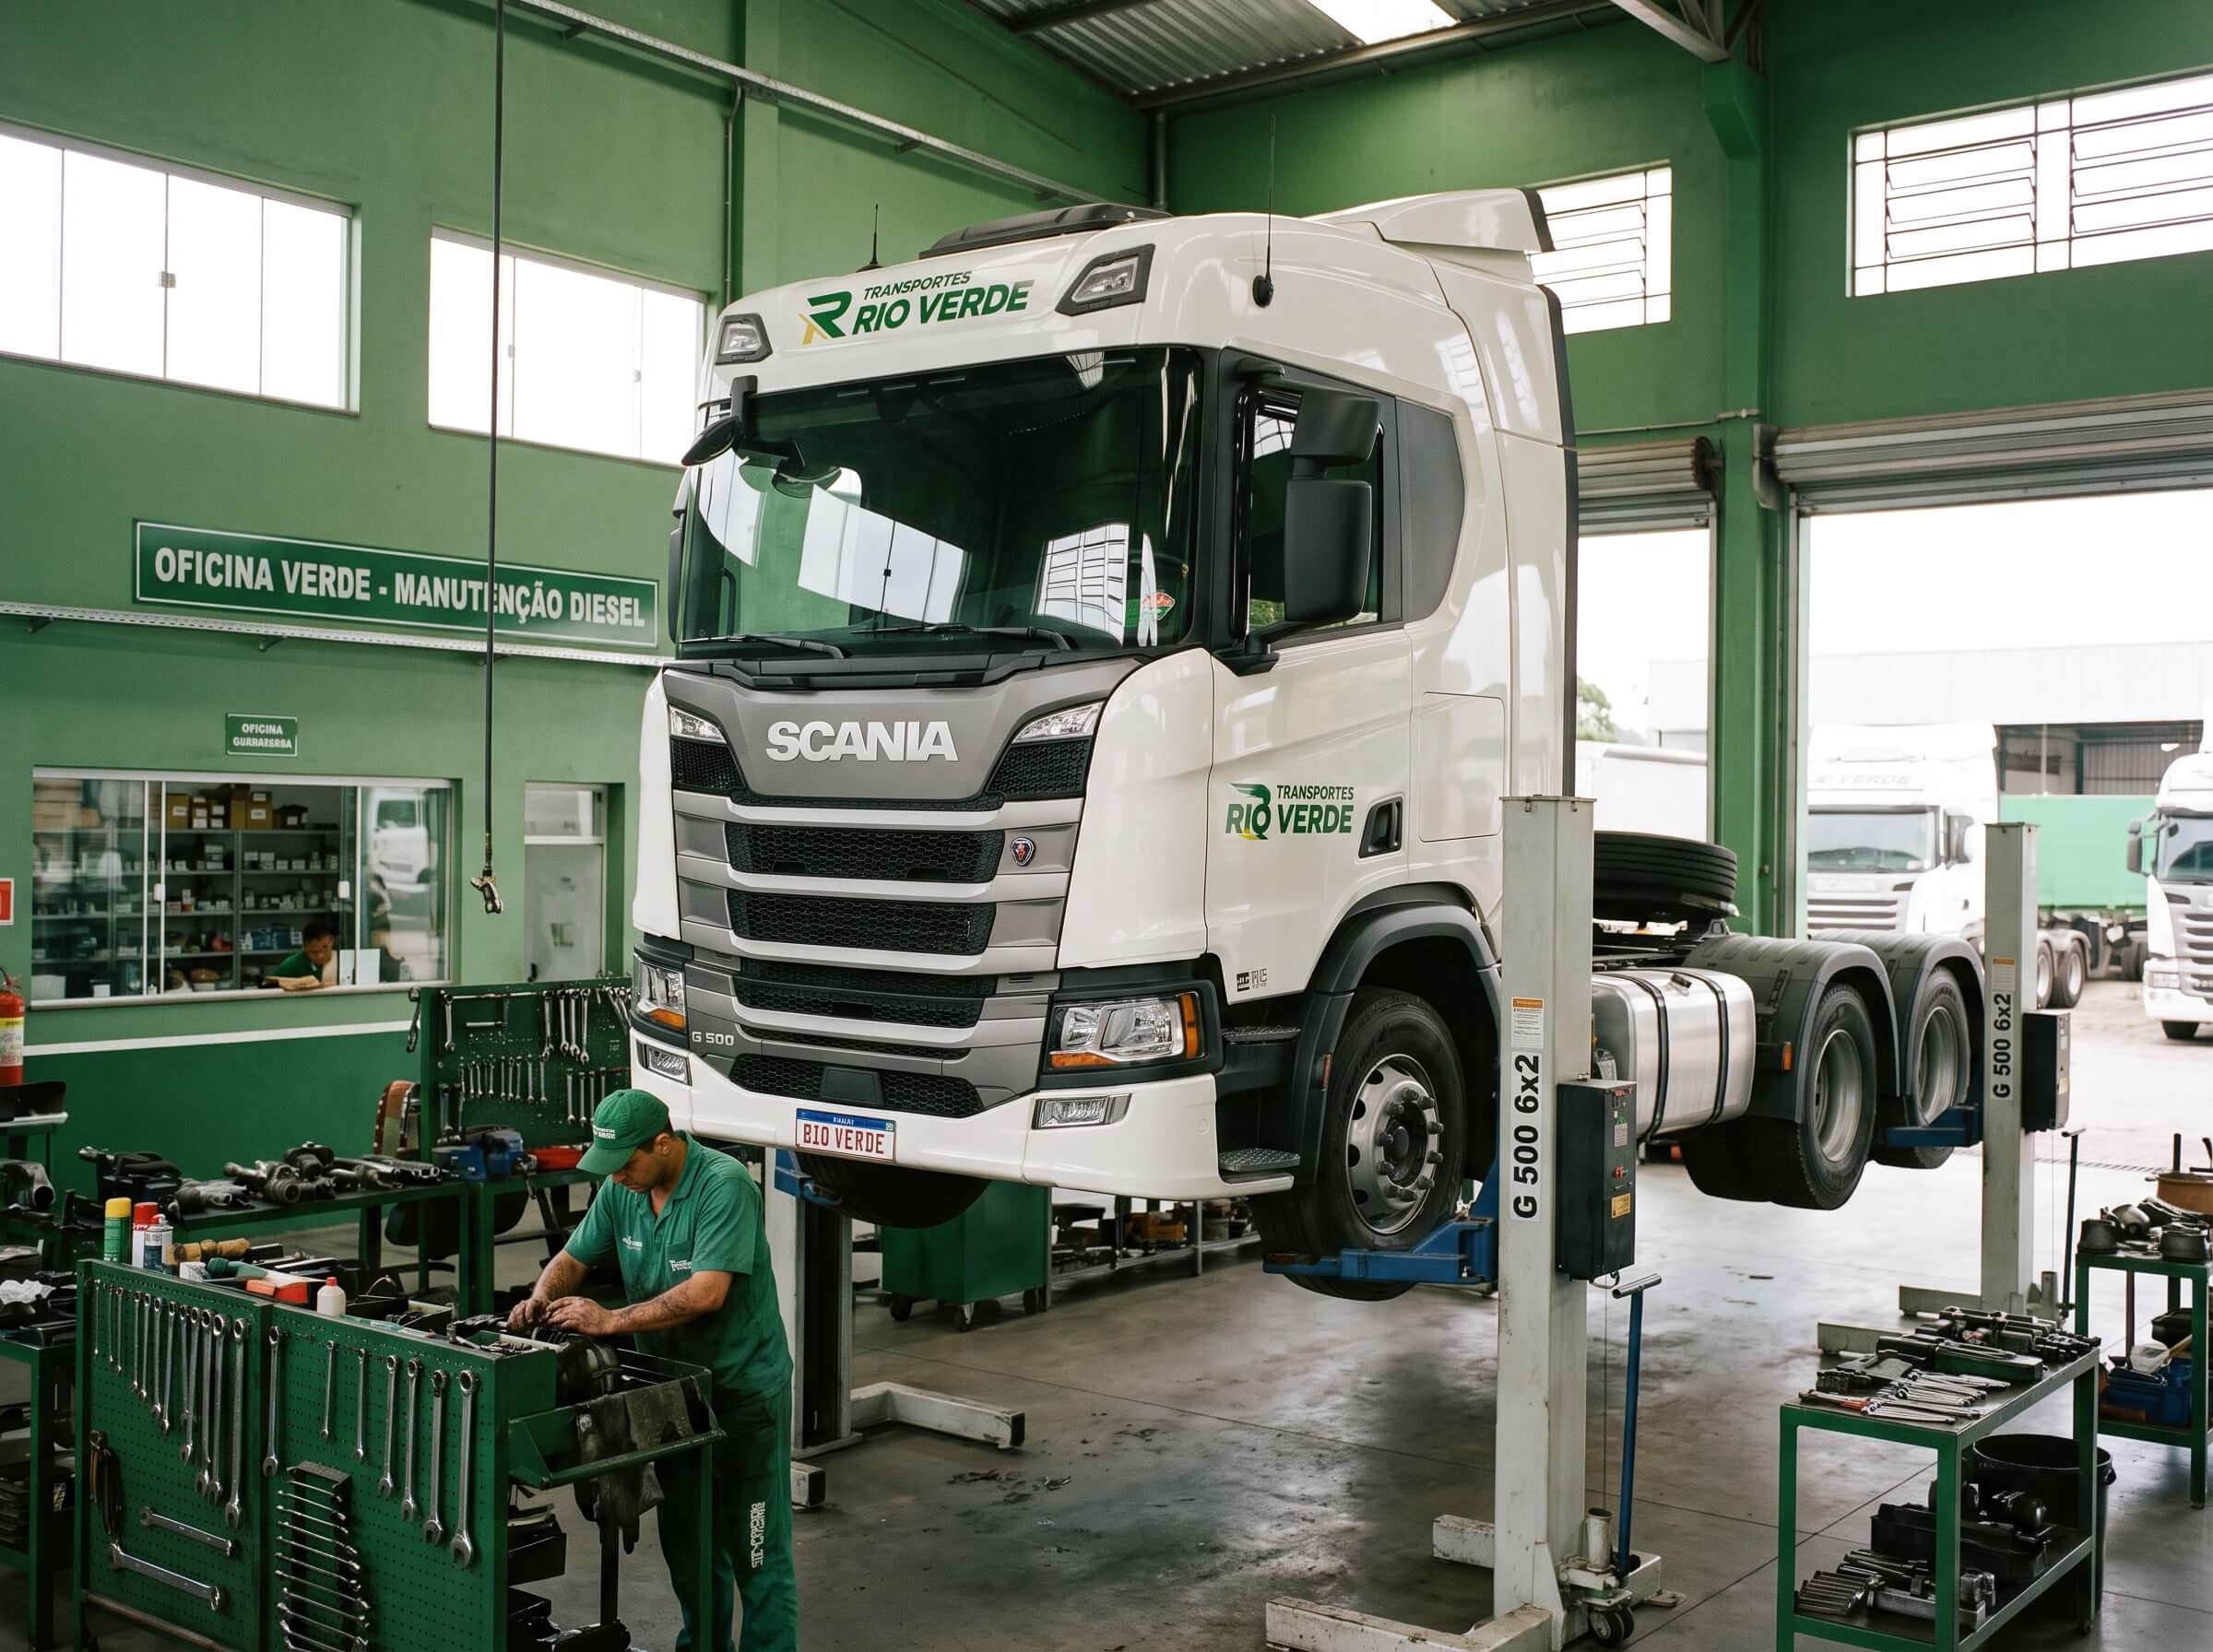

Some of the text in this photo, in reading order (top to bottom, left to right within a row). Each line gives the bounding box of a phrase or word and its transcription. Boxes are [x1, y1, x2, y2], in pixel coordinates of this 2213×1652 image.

[864, 271, 972, 300] TRANSPORTES
[852, 279, 1035, 336] RIO VERDE
[154, 547, 645, 628] OFICINA VERDE - MANUTENÇÃO DIESEL
[242, 723, 283, 735] OFICINA
[765, 721, 959, 761] SCANIA
[1276, 785, 1355, 800] TRANSPORTES
[1277, 804, 1355, 834] VERDE
[1994, 993, 2011, 1031] 6x2
[692, 1031, 735, 1046] G 500
[1993, 1038, 2011, 1076] 500
[1514, 1054, 1540, 1115] 6x2
[1993, 1083, 2011, 1098] G
[834, 1127, 885, 1154] VERDE
[1513, 1125, 1539, 1186] 500
[1512, 1195, 1538, 1219] G
